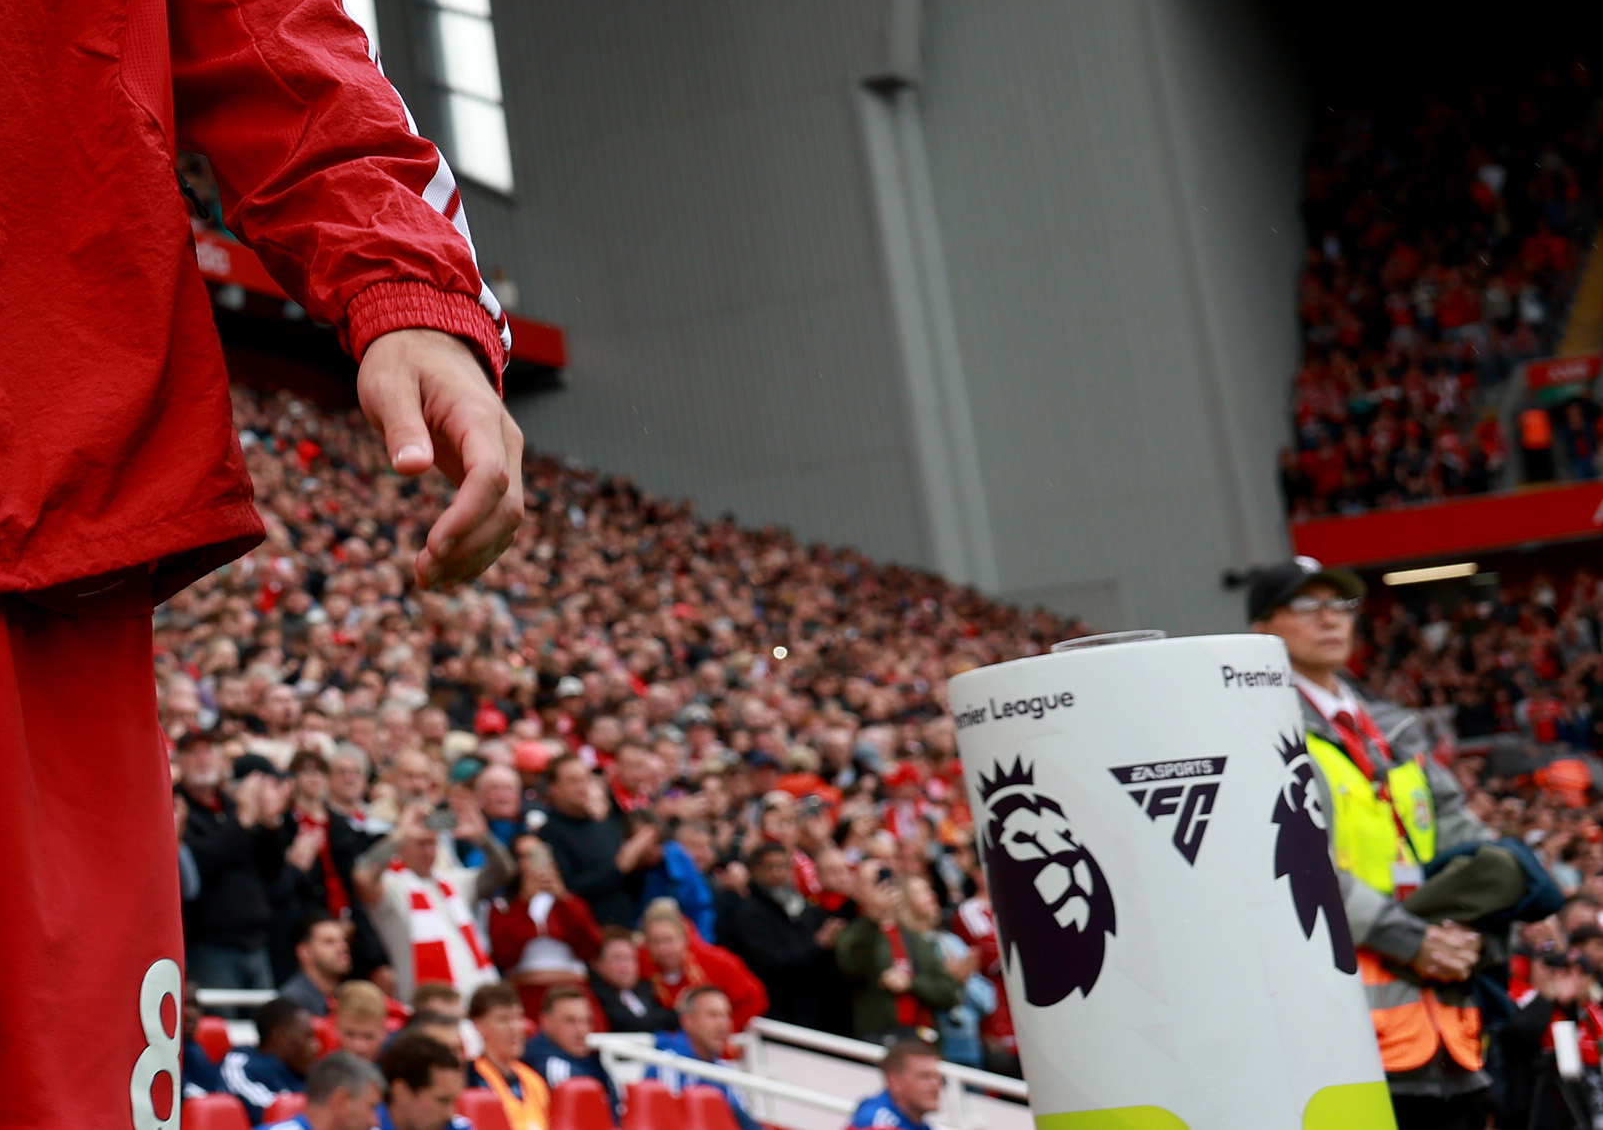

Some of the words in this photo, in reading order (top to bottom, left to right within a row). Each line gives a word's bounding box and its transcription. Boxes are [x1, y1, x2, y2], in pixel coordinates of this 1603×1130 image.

[1221, 664, 1283, 688] Premier
[989, 691, 1074, 720] League
[1154, 759, 1215, 780] SPORTS
[130, 958, 182, 1130] 8
